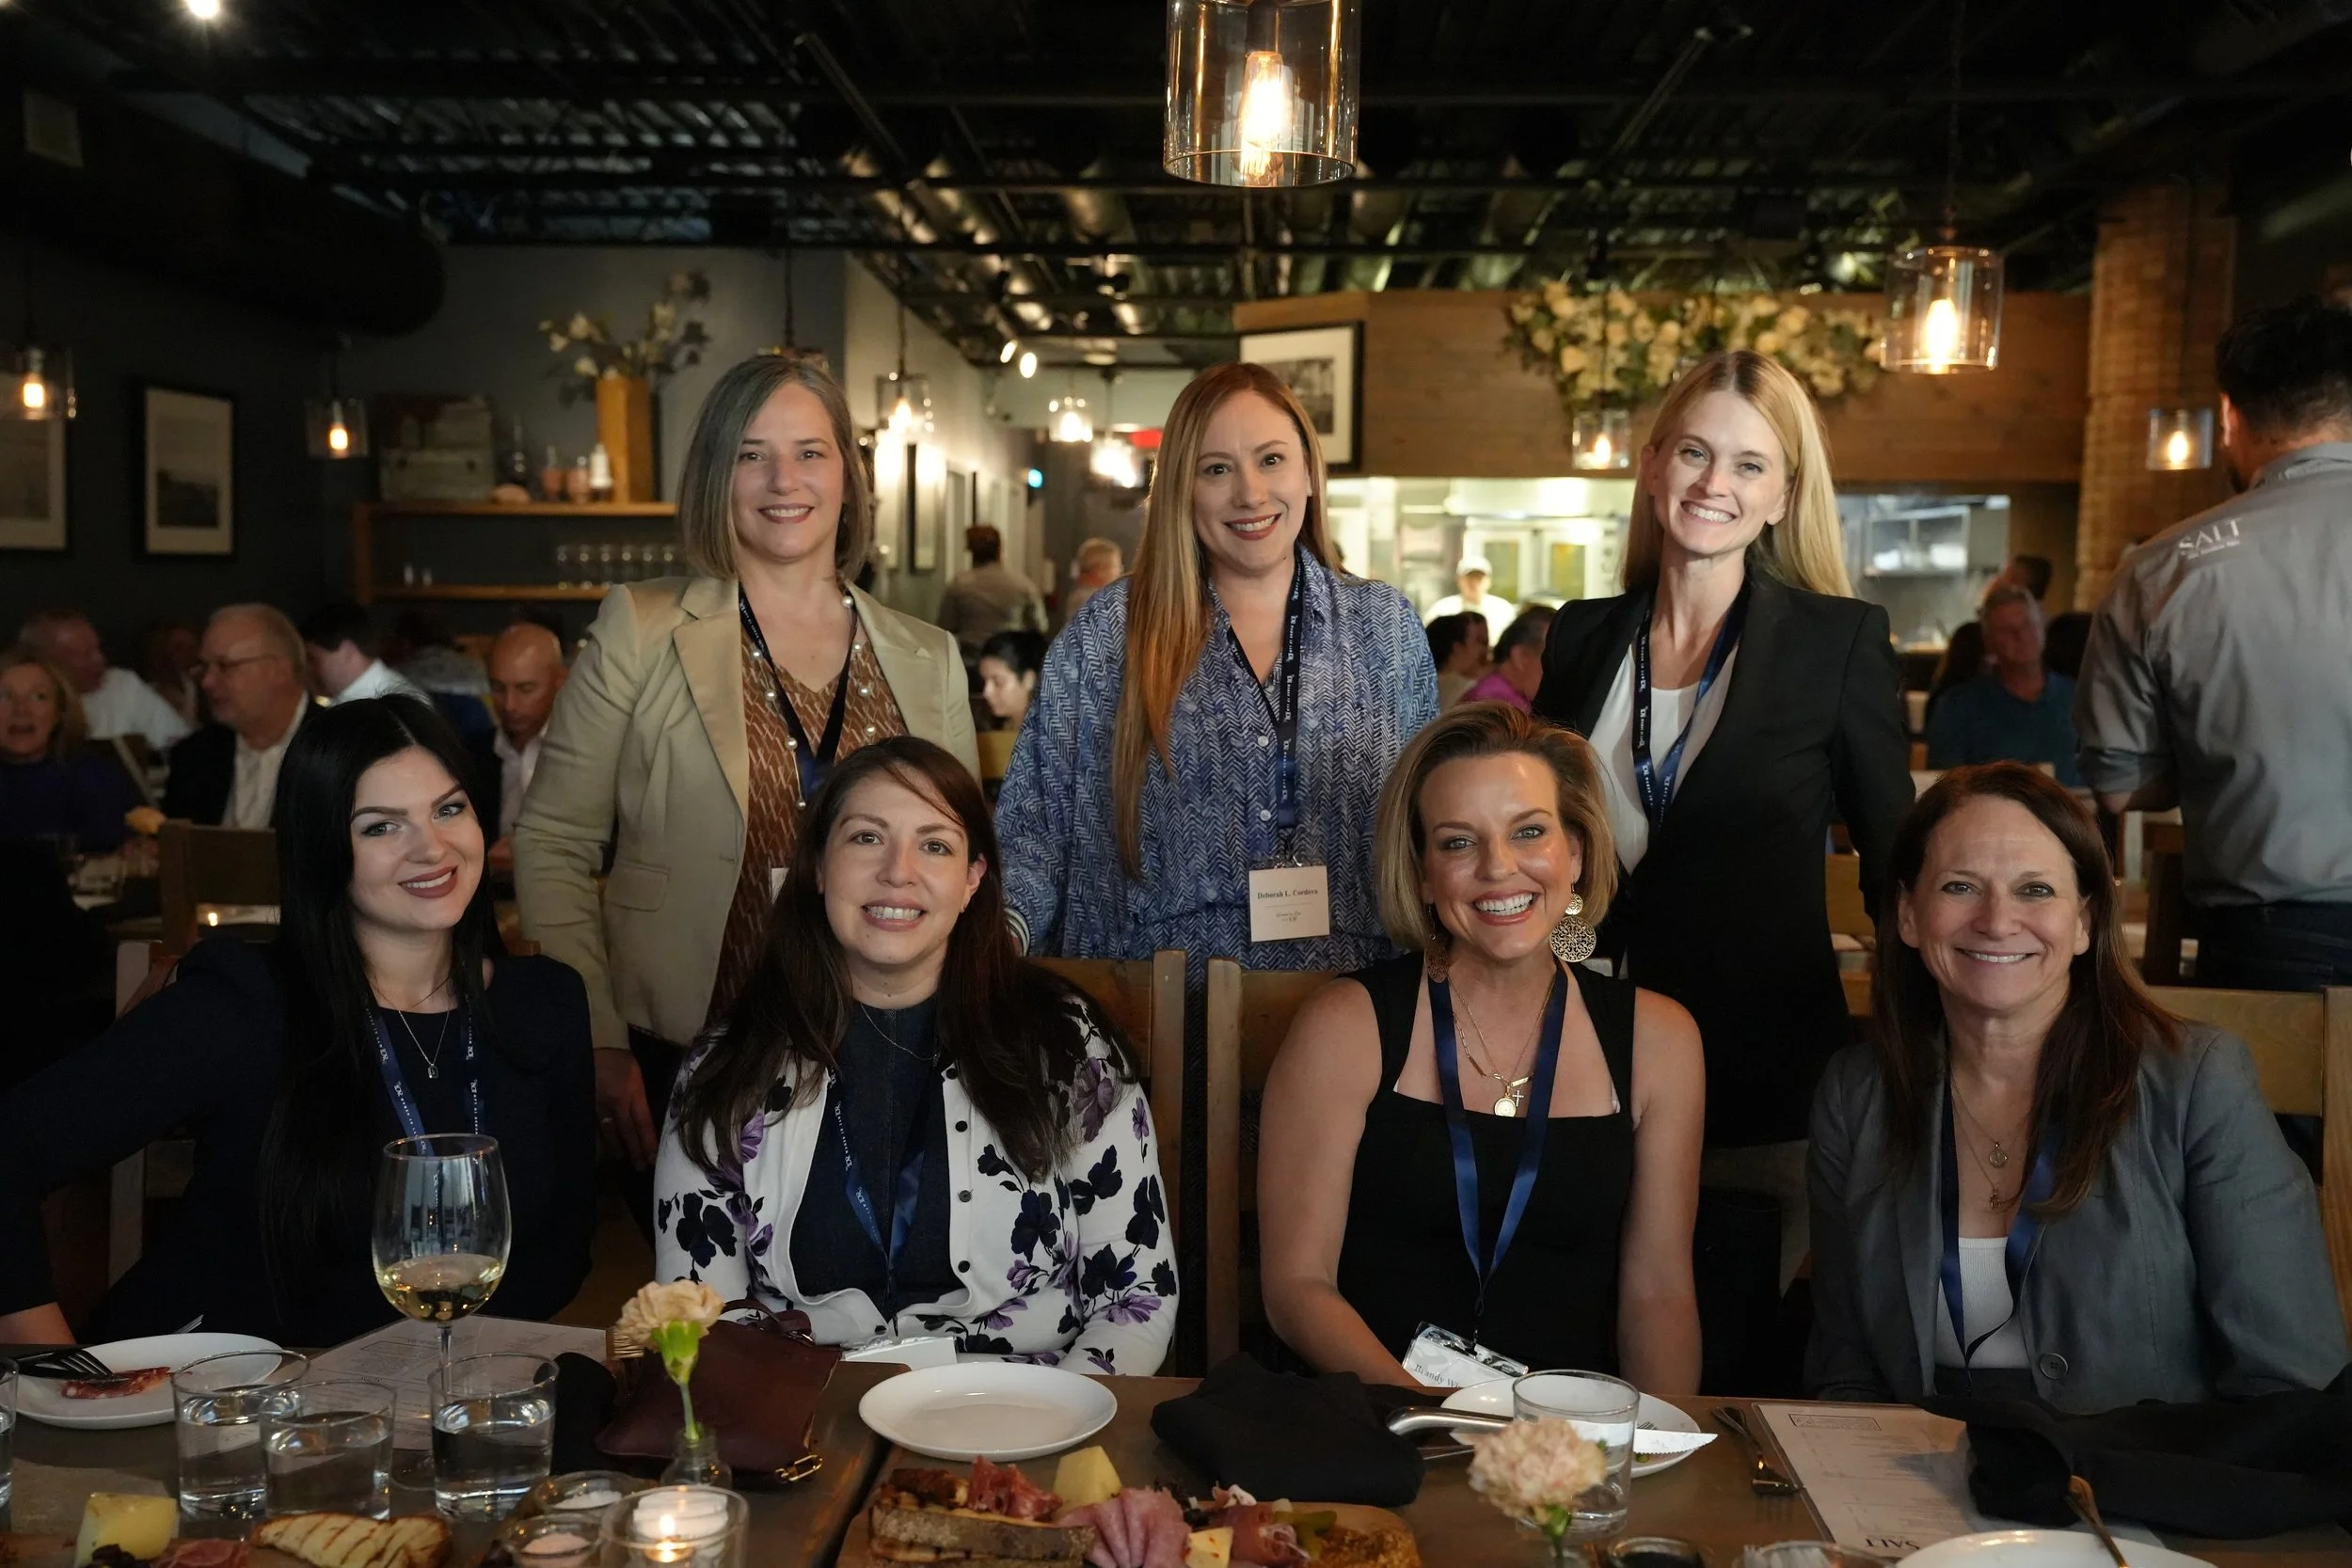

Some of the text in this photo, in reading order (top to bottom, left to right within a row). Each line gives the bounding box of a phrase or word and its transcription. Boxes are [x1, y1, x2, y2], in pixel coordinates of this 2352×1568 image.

[2179, 517, 2242, 555] SALT
[1257, 890, 1283, 899] Deborah
[1415, 1364, 1445, 1385] Brandy
[1865, 1537, 1920, 1551] SALT
